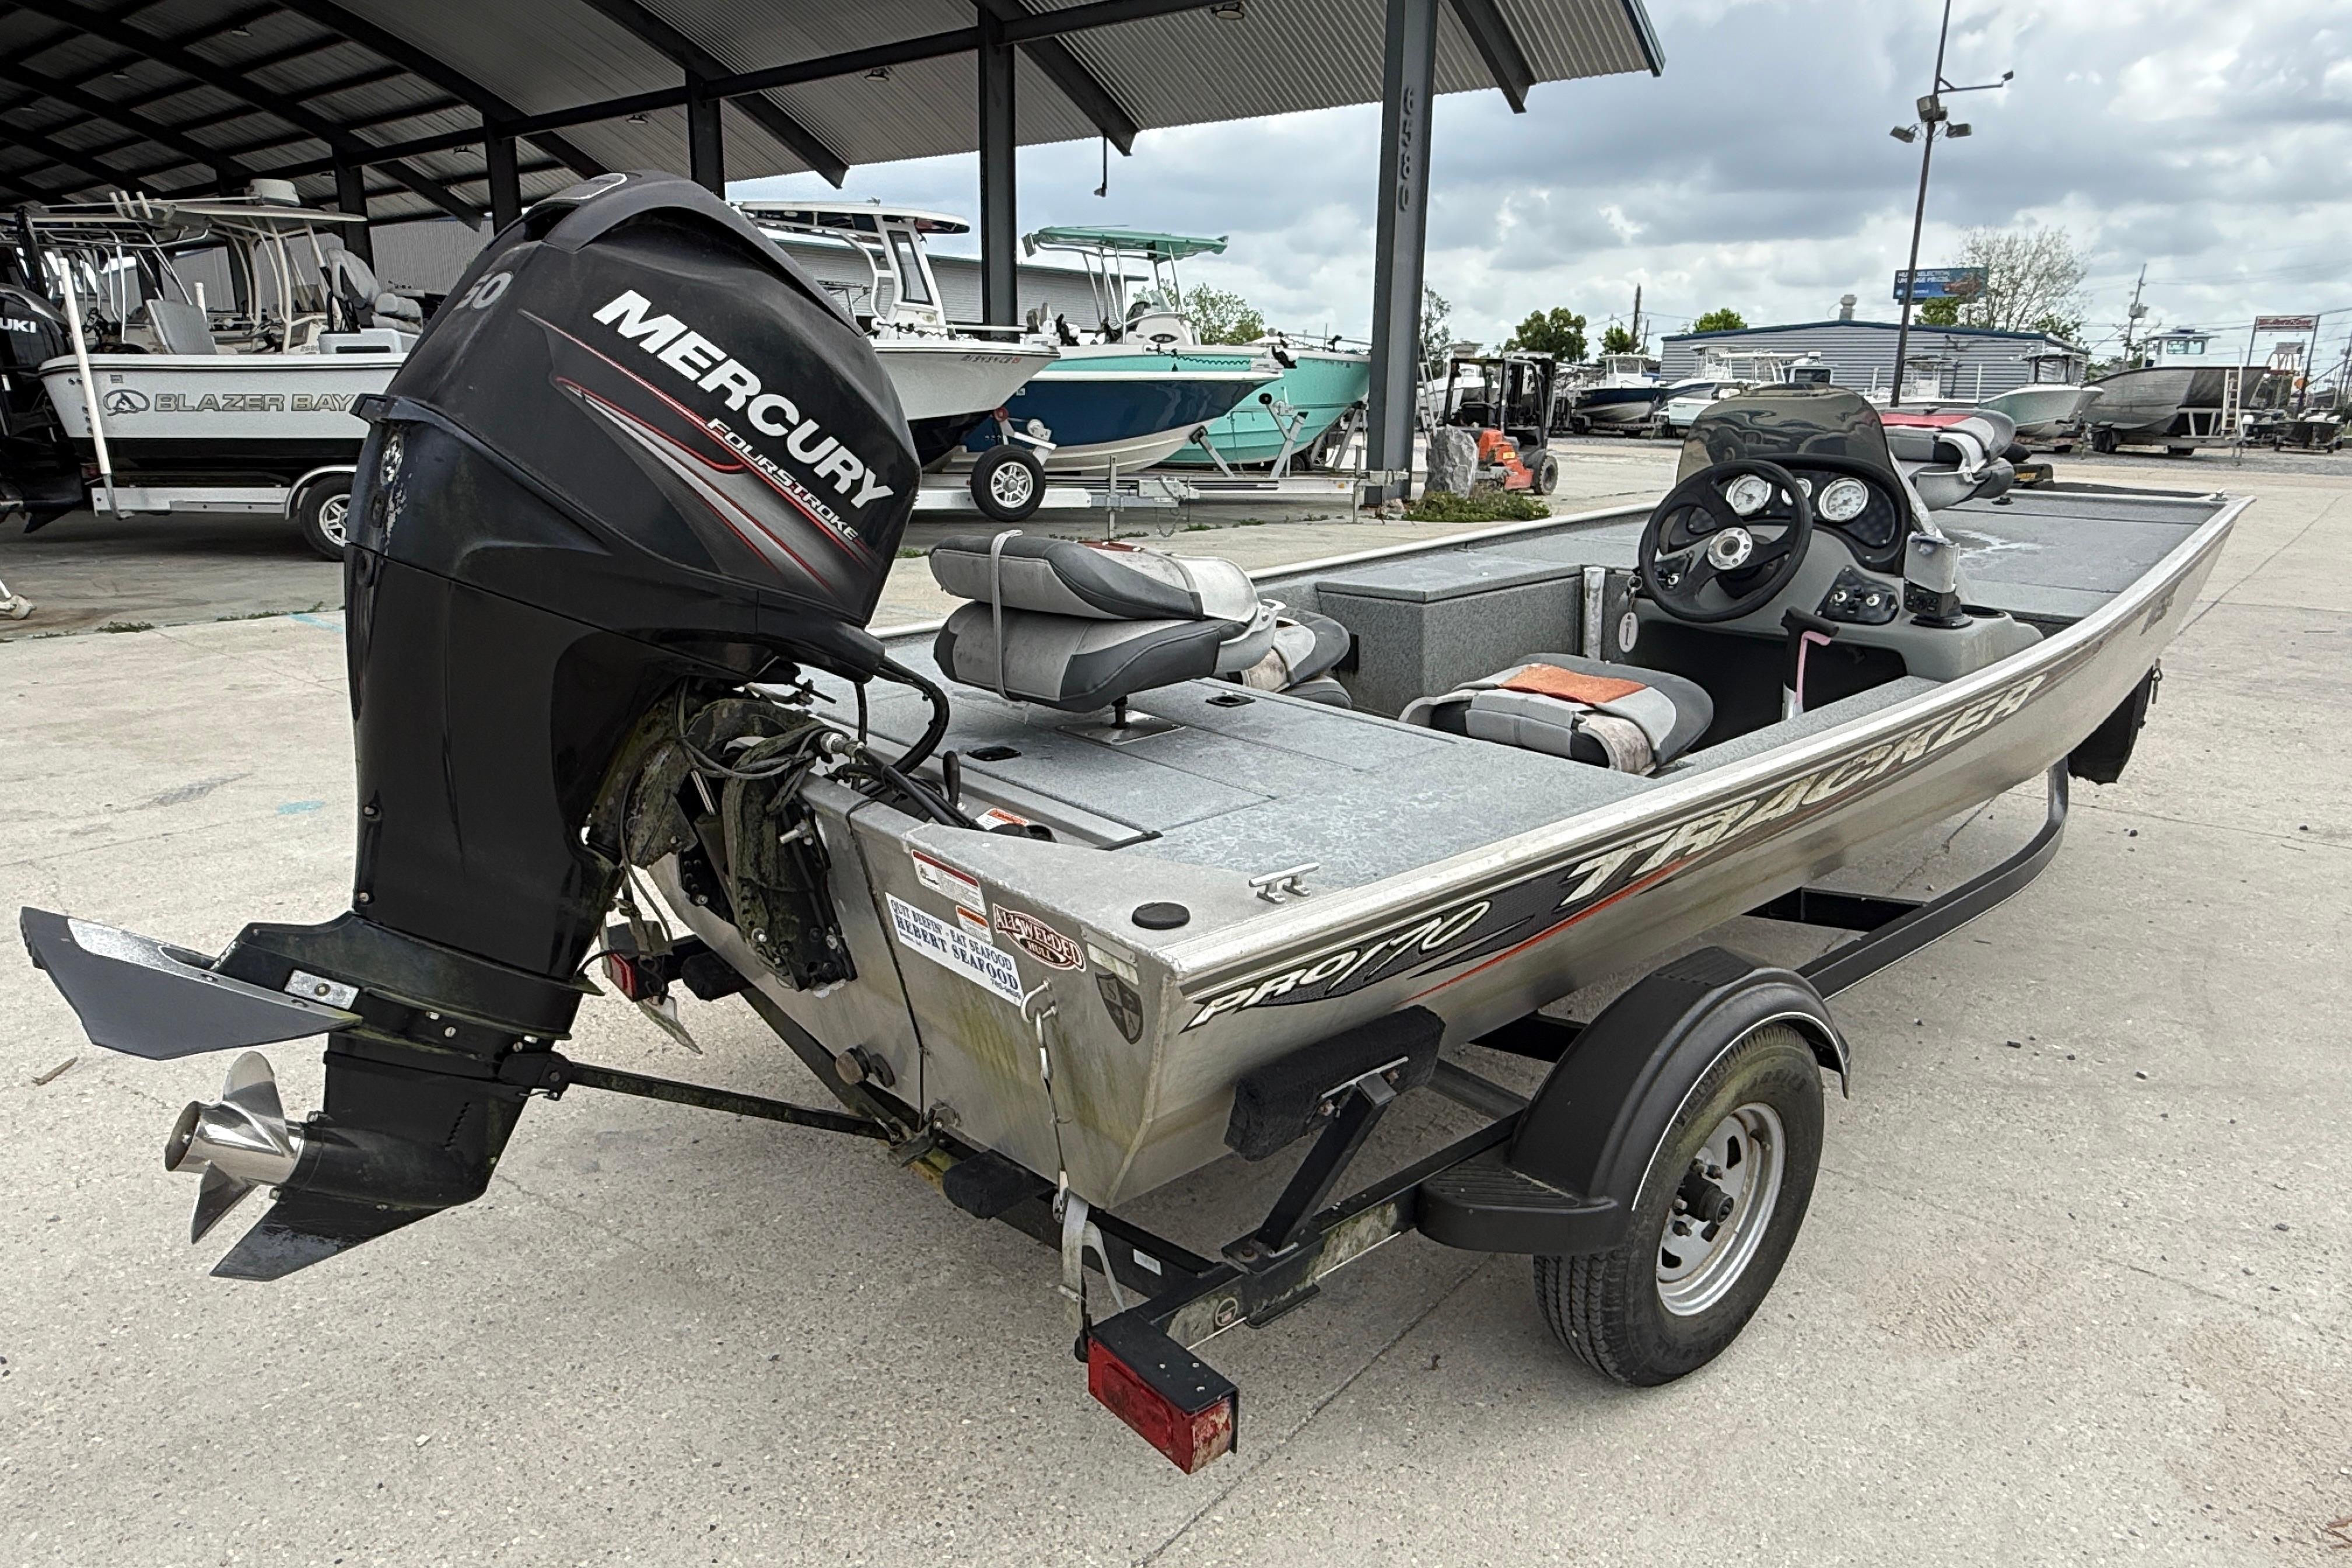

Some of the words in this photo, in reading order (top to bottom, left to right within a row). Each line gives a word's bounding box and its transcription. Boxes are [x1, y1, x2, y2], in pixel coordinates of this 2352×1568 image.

[155, 394, 285, 412] BLAZER
[291, 394, 355, 412] BAY
[593, 289, 894, 509] MERCURY
[706, 418, 859, 540] FOURSTROKE
[1555, 671, 2048, 909] TRACKER
[895, 914, 947, 953] HEBERT
[950, 943, 1019, 990] SEAFOOD
[950, 929, 967, 948] EAT
[968, 938, 1013, 971] SEAFOOD
[1027, 940, 1054, 961] HULL
